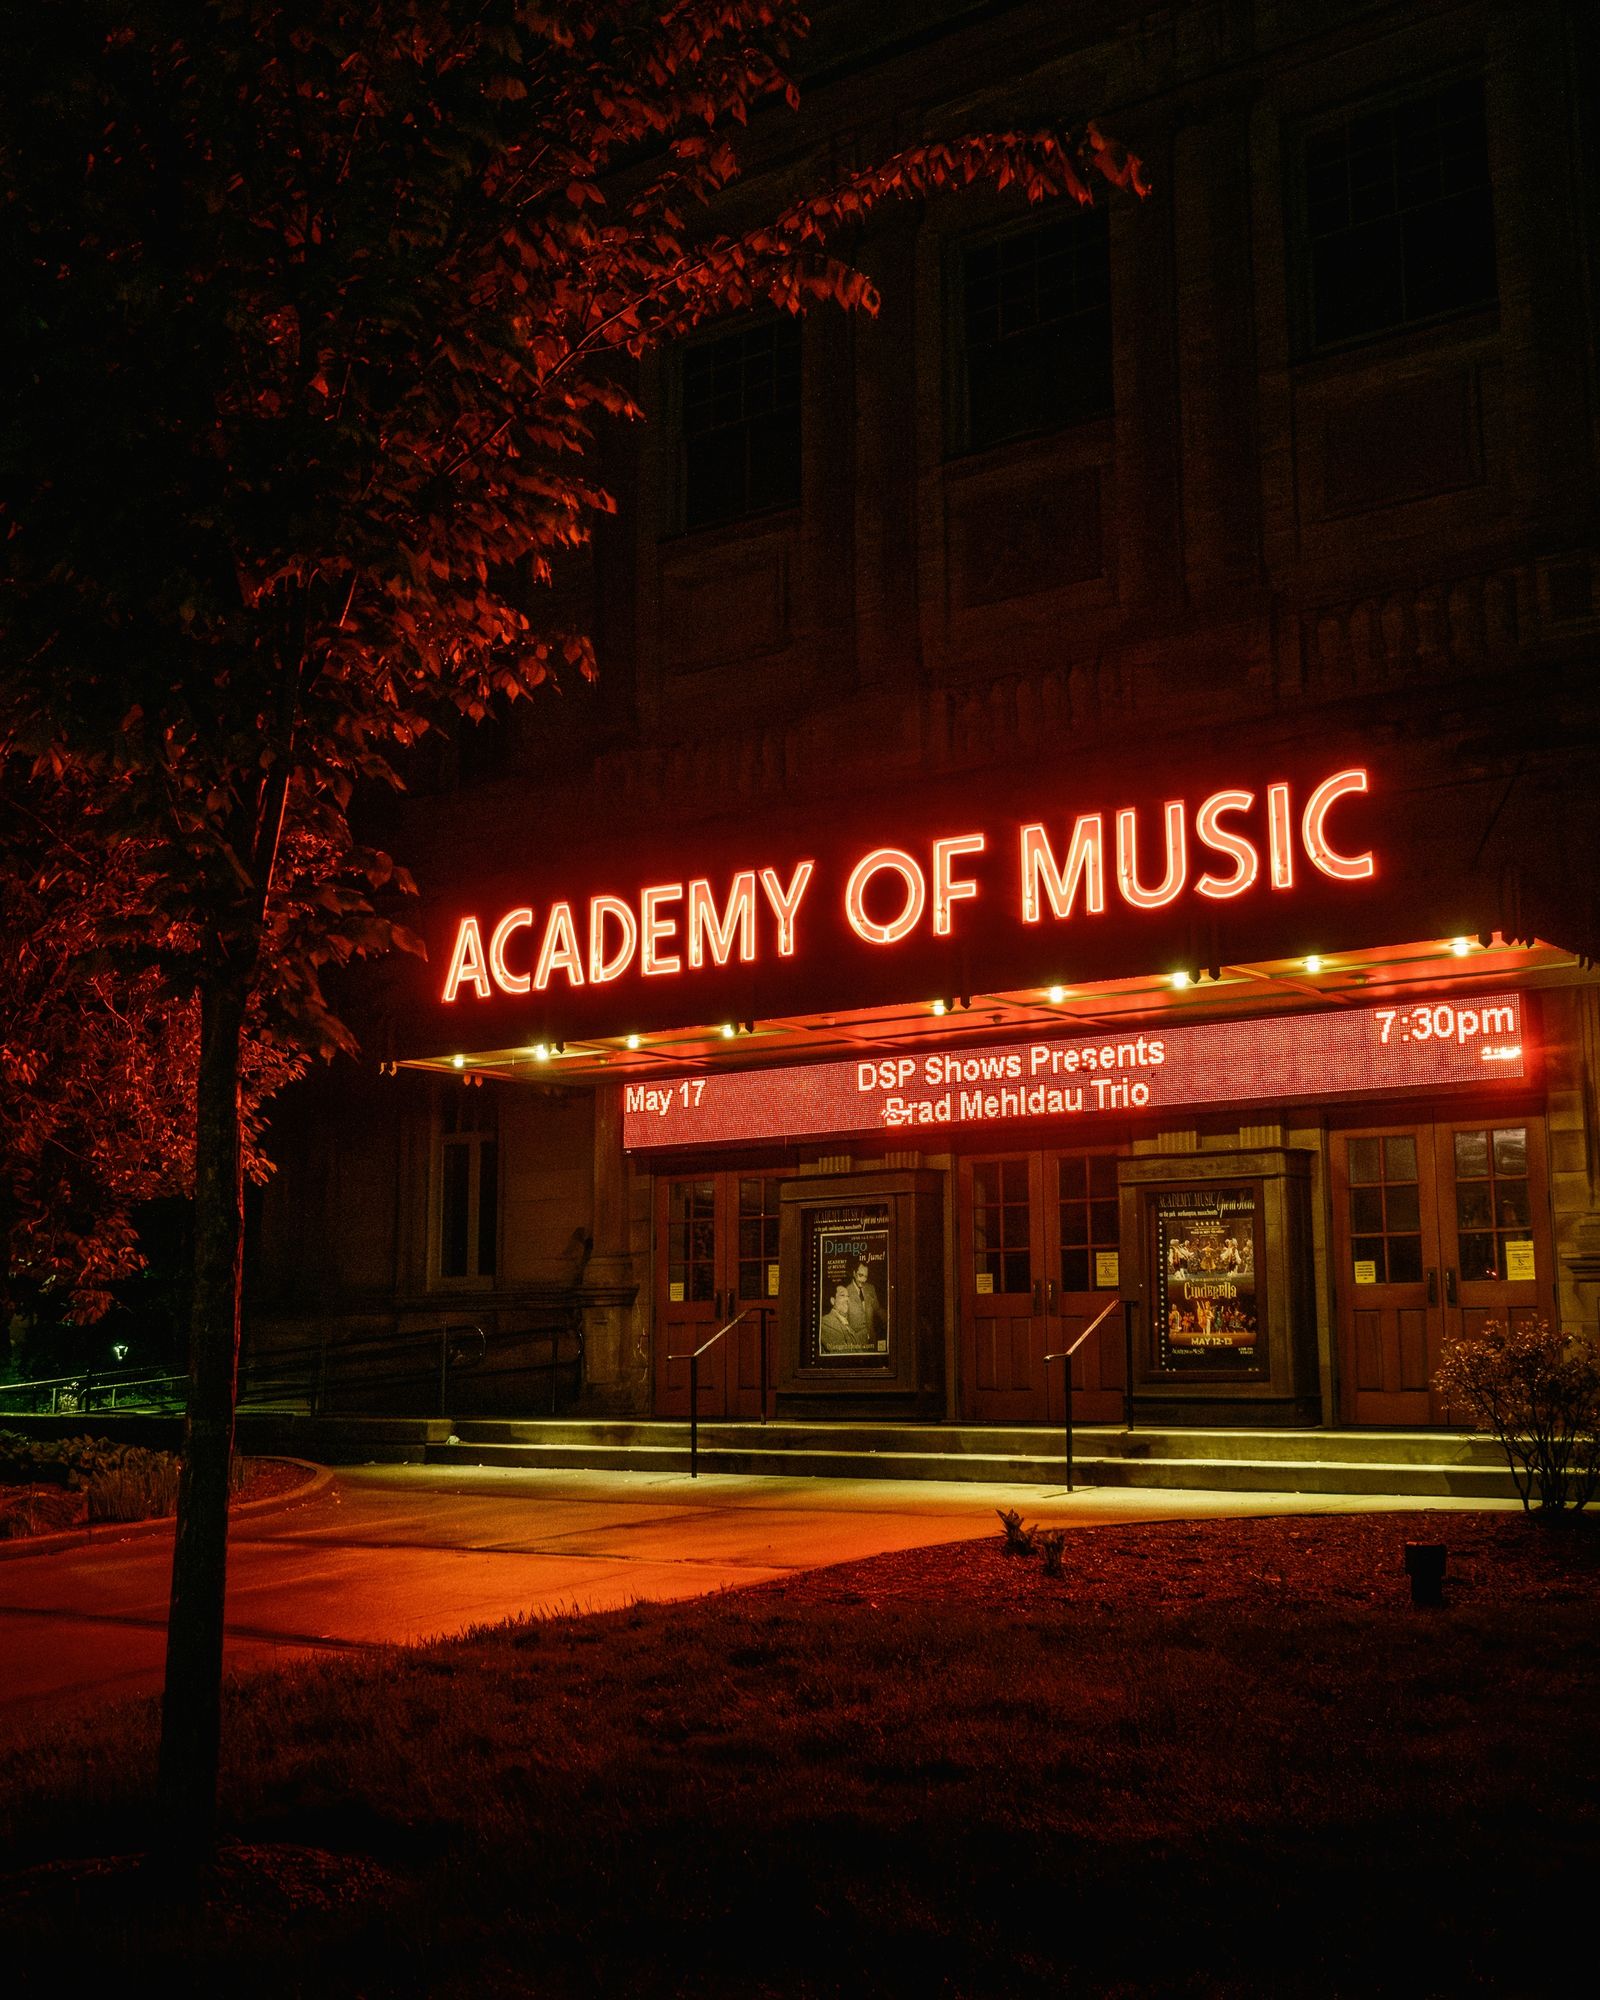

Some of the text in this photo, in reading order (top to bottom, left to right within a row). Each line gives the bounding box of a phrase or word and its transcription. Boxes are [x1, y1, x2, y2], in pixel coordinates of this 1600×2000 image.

[441, 767, 1376, 1004] ACADEMY OF MUSIC
[1375, 1005, 1514, 1044] 7:30pm
[857, 1035, 1165, 1092] DSP Shows Presents
[626, 1080, 706, 1116] May 17
[959, 1084, 1083, 1121] Mehldau
[1090, 1077, 1149, 1109] Trio
[824, 1240, 868, 1257] Django
[1191, 1337, 1211, 1346] MAY
